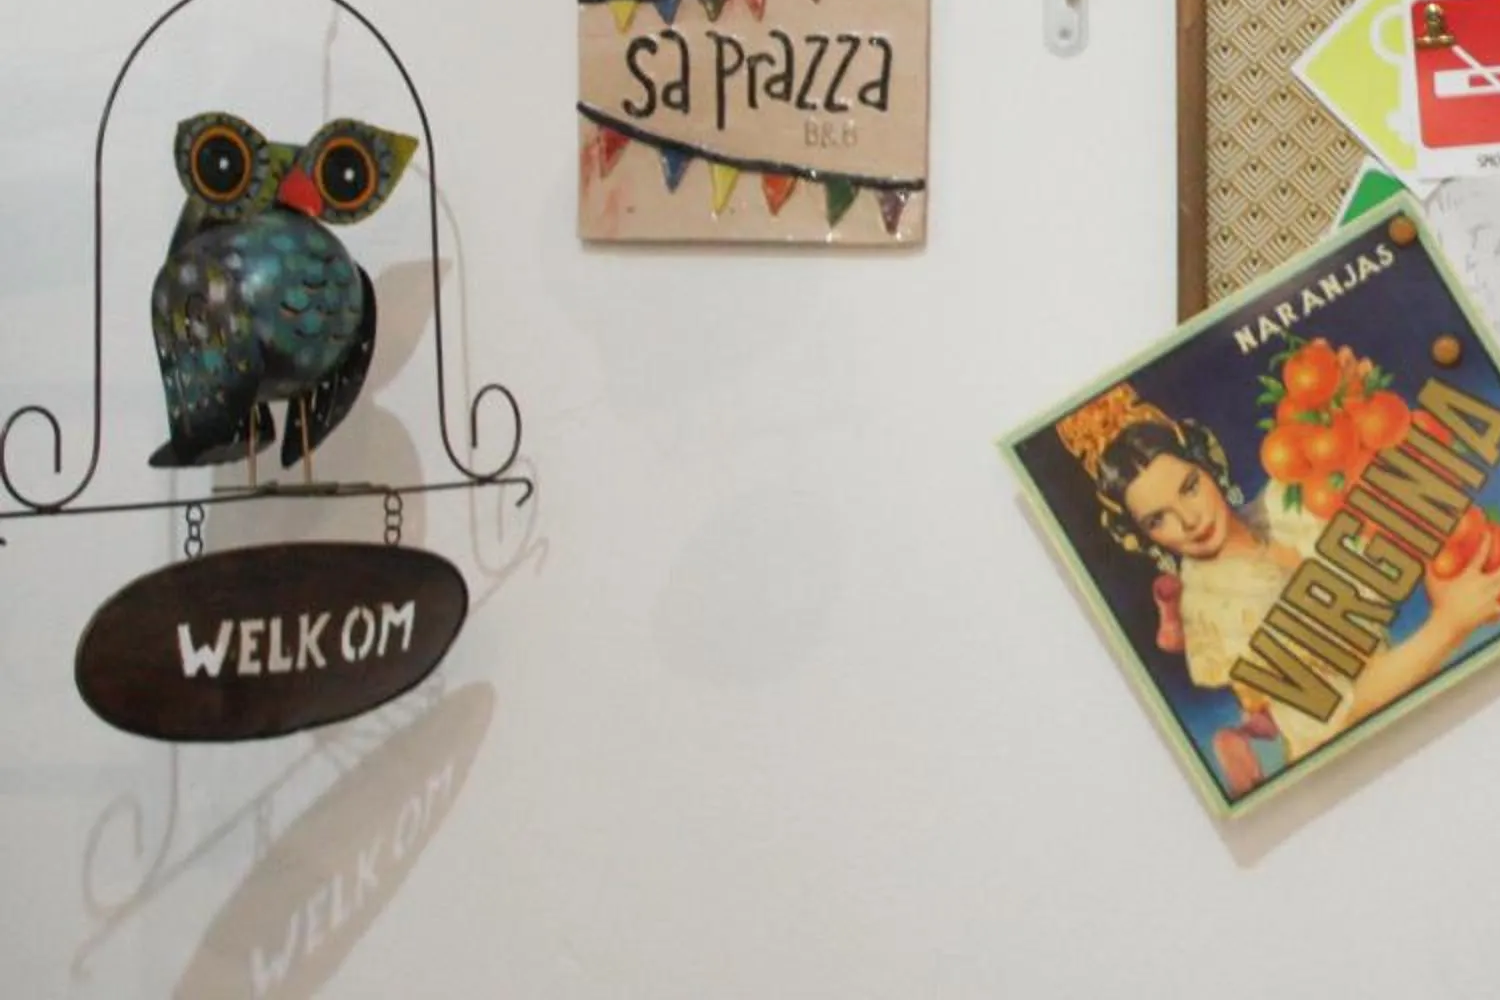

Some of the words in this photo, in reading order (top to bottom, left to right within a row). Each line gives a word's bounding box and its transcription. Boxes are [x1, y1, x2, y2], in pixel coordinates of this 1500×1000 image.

[622, 30, 690, 118] sa
[705, 30, 893, 130] prazza
[804, 122, 858, 148] B&B
[1233, 245, 1395, 354] NARANJAS
[178, 601, 415, 678] WELKOM
